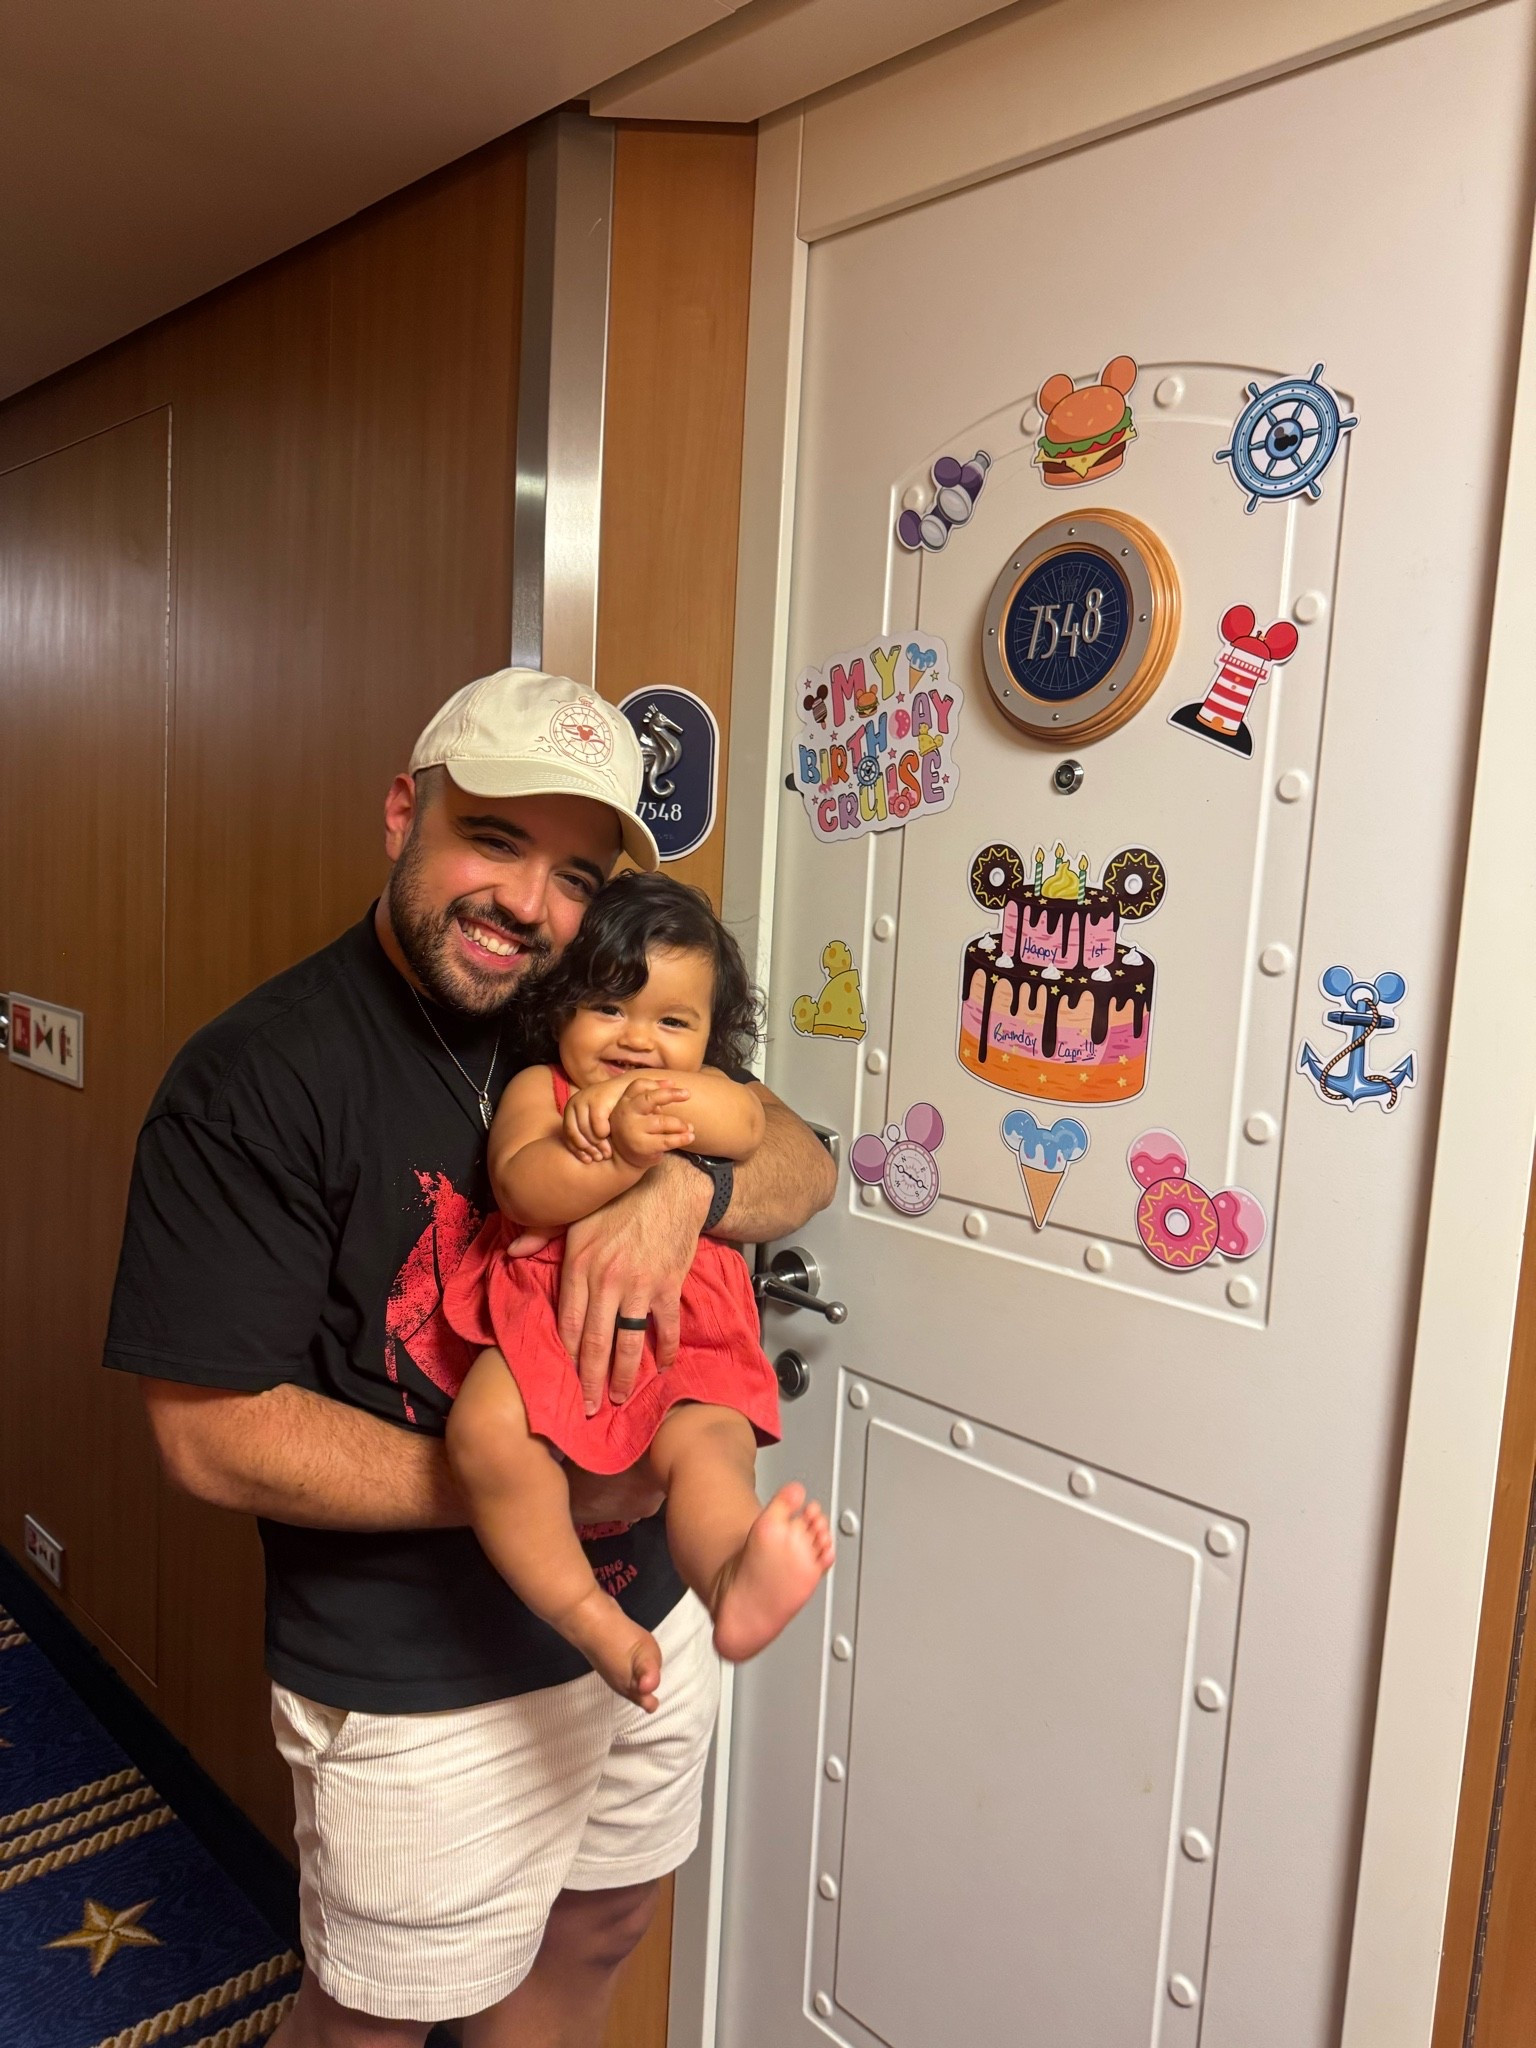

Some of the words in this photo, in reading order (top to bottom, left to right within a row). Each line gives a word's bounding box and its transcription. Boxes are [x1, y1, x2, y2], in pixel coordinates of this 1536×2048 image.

[1026, 587, 1103, 660] 7548
[829, 644, 902, 728] MY
[638, 801, 682, 822] 7548
[817, 747, 945, 833] CRUISE
[1022, 936, 1058, 964] Happy
[1091, 943, 1107, 958] 1st
[993, 1022, 1037, 1057] Birthday
